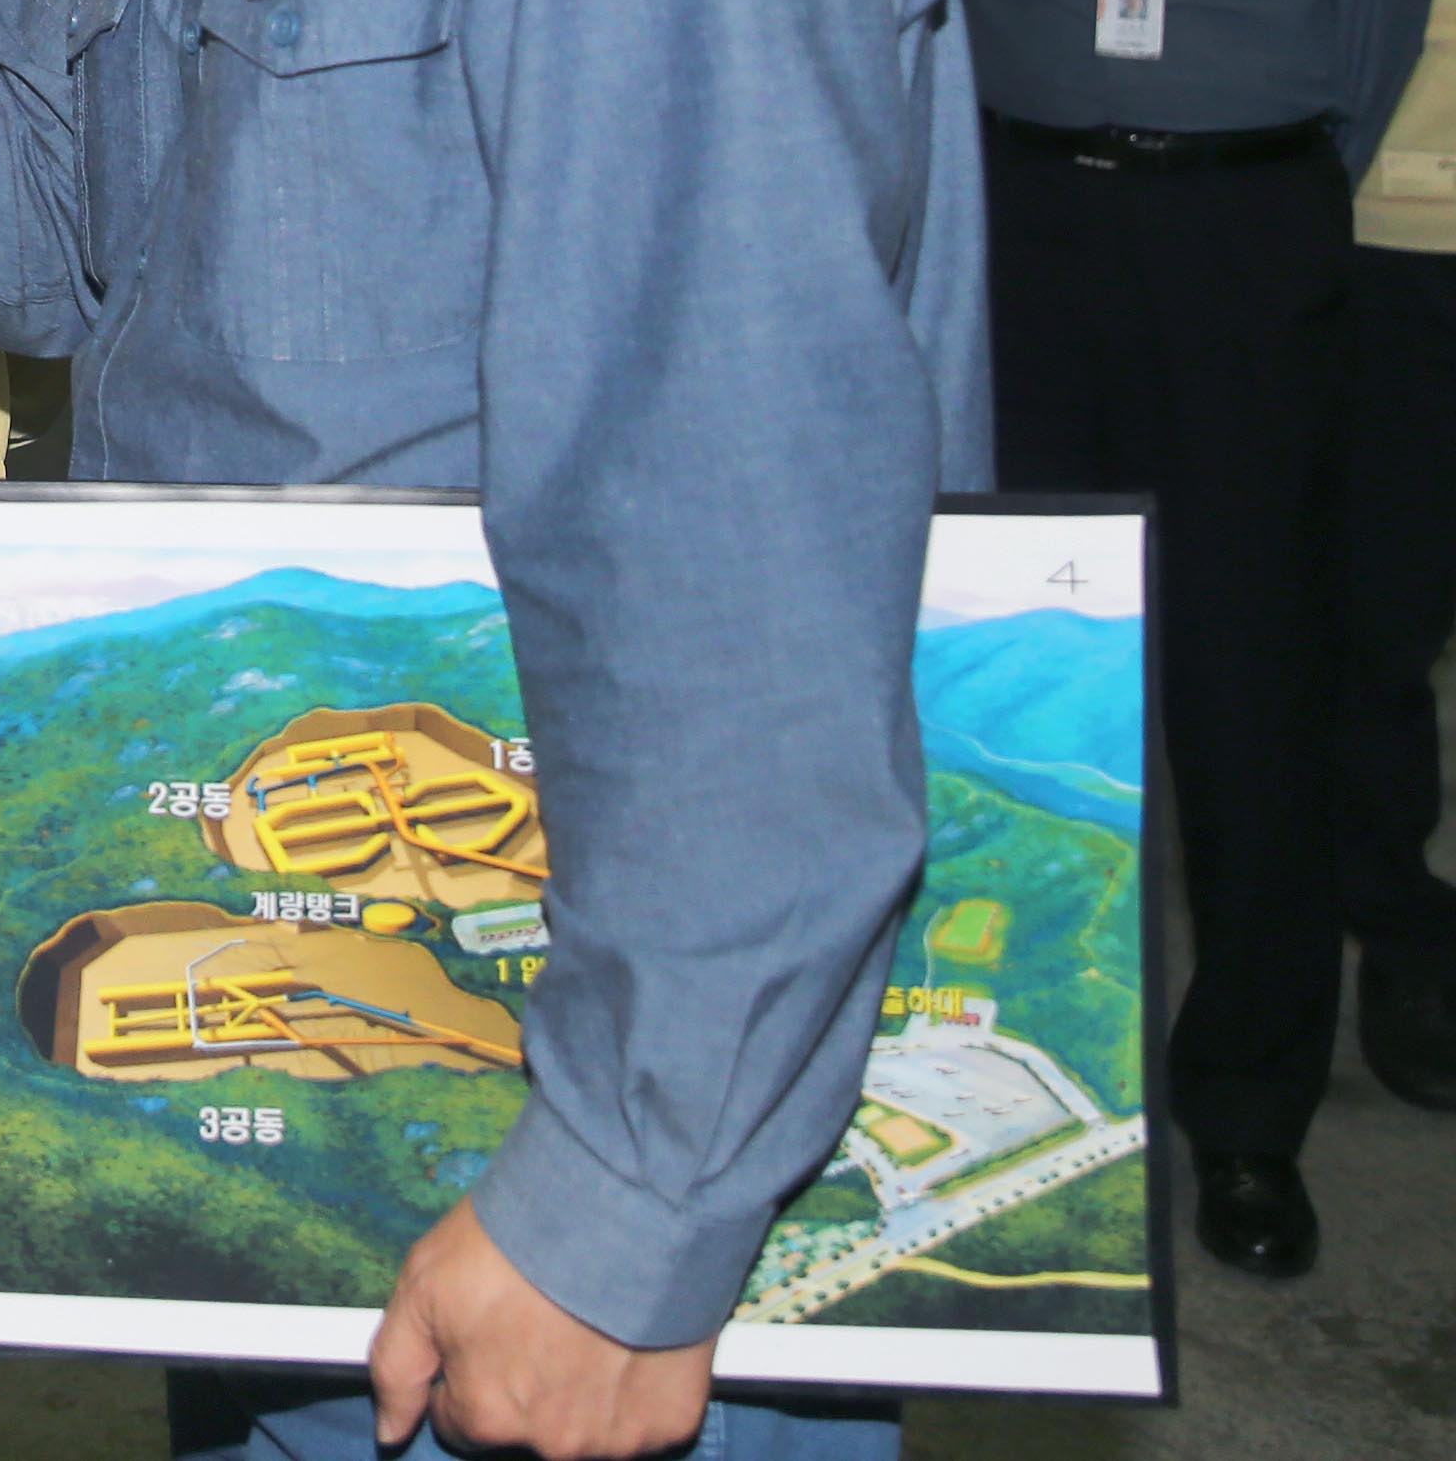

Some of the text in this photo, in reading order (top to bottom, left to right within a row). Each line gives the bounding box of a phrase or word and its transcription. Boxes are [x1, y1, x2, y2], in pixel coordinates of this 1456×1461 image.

[1045, 558, 1091, 595] 4
[147, 781, 233, 819] 2공동
[198, 1105, 285, 1146] 3공동
